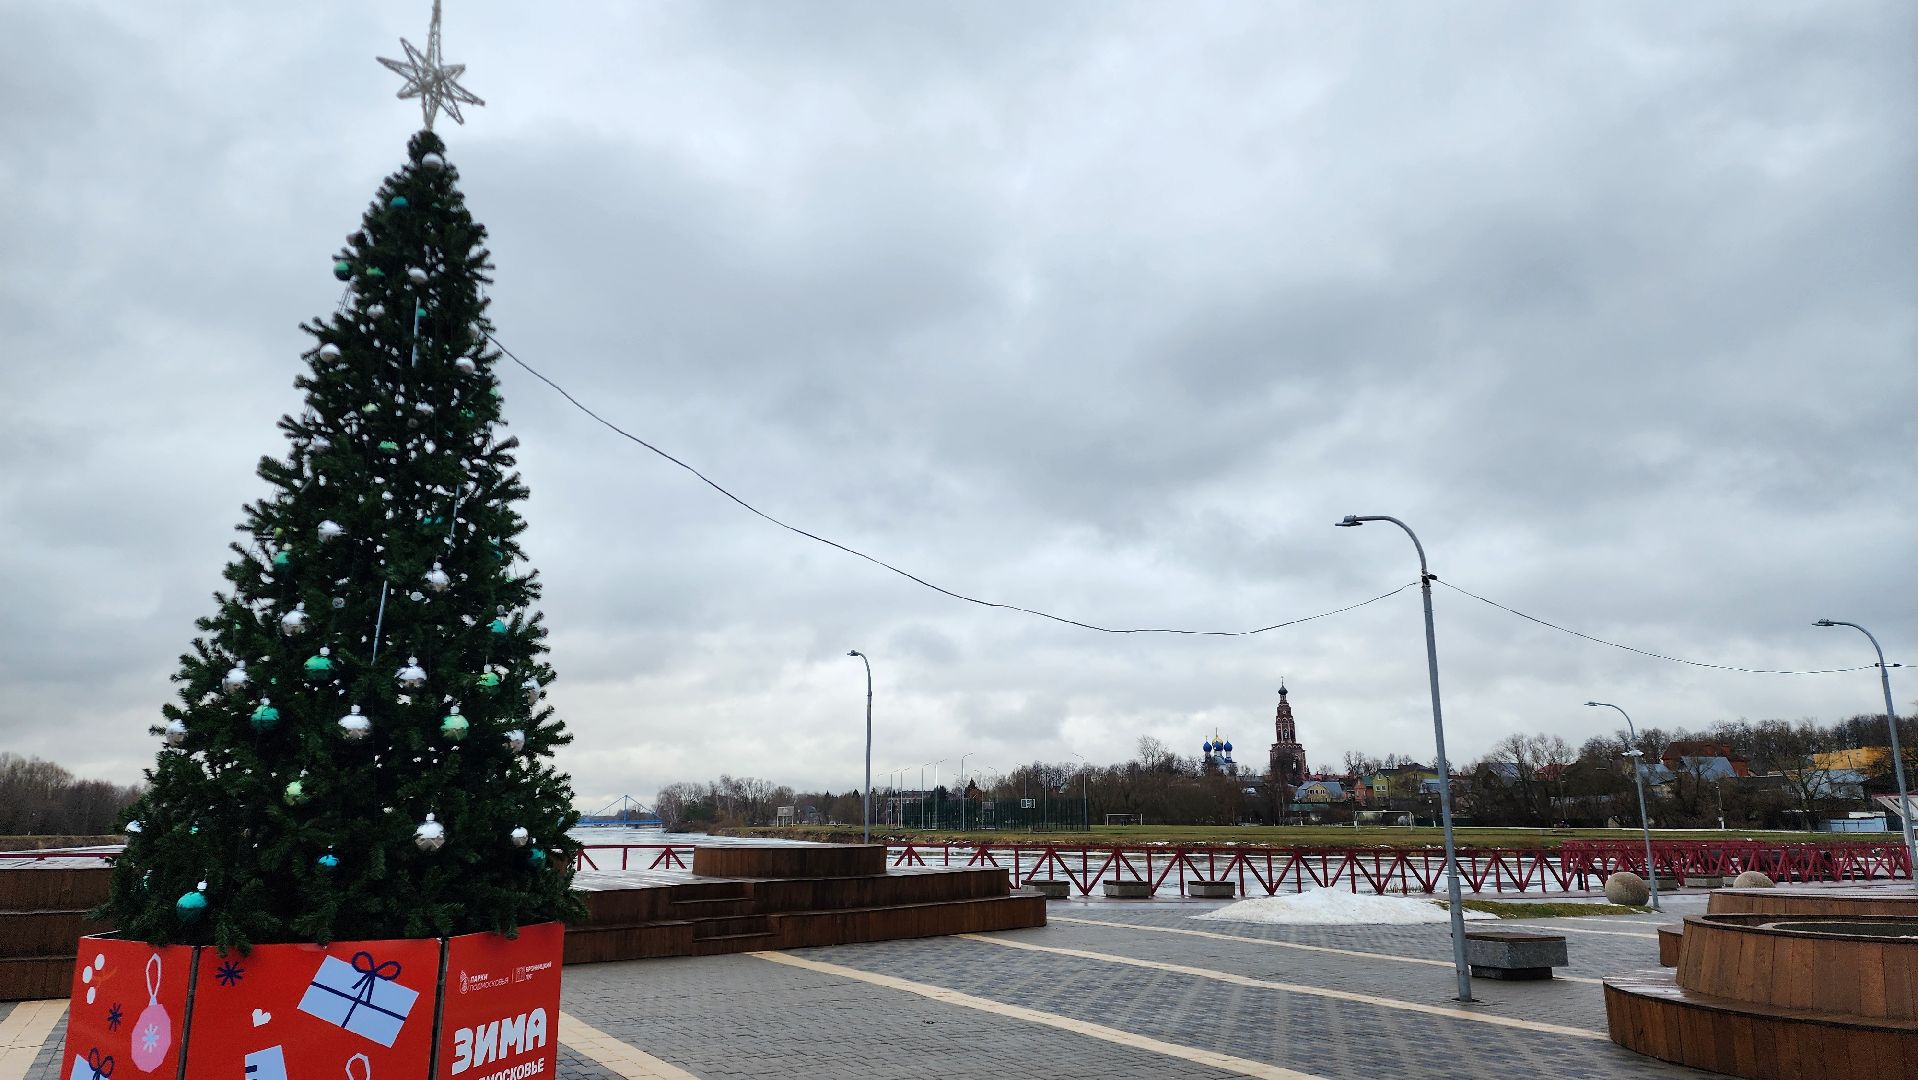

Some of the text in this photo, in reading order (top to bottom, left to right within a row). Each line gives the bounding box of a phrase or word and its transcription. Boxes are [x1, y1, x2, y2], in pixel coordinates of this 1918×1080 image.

[469, 976, 509, 992] ПОДМОСКОВЬЯ
[470, 973, 489, 983] ПАРКИ
[451, 1007, 547, 1076] ЗИМА
[478, 1057, 545, 1080] ОСКОВЬЕ
